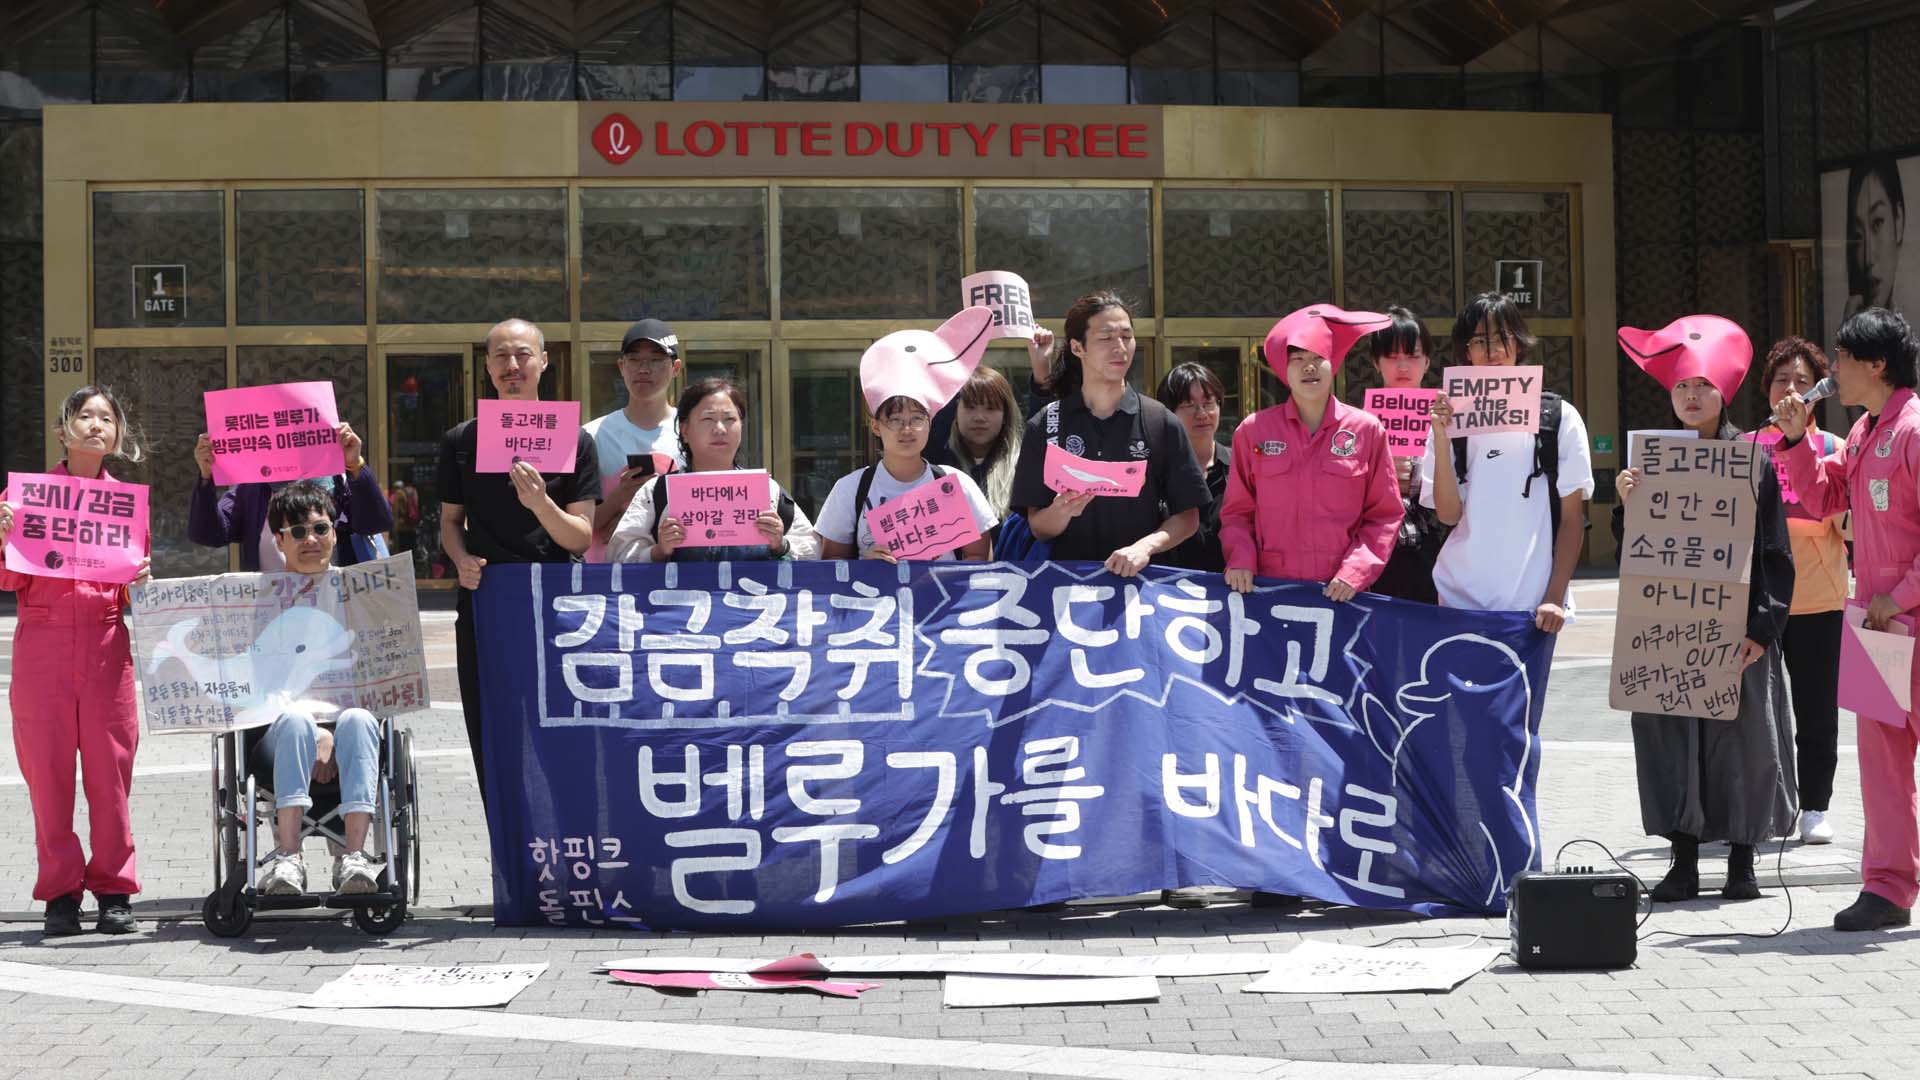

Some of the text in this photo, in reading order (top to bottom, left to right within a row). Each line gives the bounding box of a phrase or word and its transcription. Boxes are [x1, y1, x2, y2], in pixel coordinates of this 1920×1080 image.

[655, 121, 1149, 158] LOTTE DUTY FREE
[153, 271, 166, 296] 1
[1512, 266, 1525, 289] 1
[143, 299, 176, 312] GATE
[970, 284, 1029, 308] FREE
[50, 356, 83, 373] 300
[1447, 376, 1534, 398] EMPTY
[1473, 396, 1508, 412] the
[224, 406, 320, 432] 롯데는 벨루가
[500, 412, 558, 430] 돌고래를
[1453, 409, 1530, 430] TANKS!
[212, 427, 337, 455] 방류약속 이행하라
[505, 436, 552, 453] 바다로!
[1388, 434, 1409, 447] the
[1641, 438, 1750, 479] 돌고래는
[22, 482, 136, 518] 전시/감금
[691, 485, 748, 502] 바다에서
[681, 507, 761, 527] 살아갈 권리
[879, 498, 940, 534] 벨루가를
[1649, 490, 1737, 528] 인간의
[22, 513, 131, 549] 중단하라
[888, 524, 939, 553] 바다로
[1629, 534, 1733, 570] 소유물이
[216, 582, 259, 600] 아니라
[1642, 581, 1732, 611] 아니다
[552, 572, 1344, 706] 감금착취 중단하고
[1631, 618, 1723, 652] 아쿠아리움
[1686, 642, 1742, 668] OUT!
[203, 682, 250, 698] 자유롭게
[1619, 663, 1708, 698] 벨루가 감금
[1655, 683, 1740, 719] 전시 반대
[637, 736, 1406, 915] 벨루가를 바다로
[528, 835, 630, 883] 핫핑크
[538, 887, 643, 925] 돌핀스
